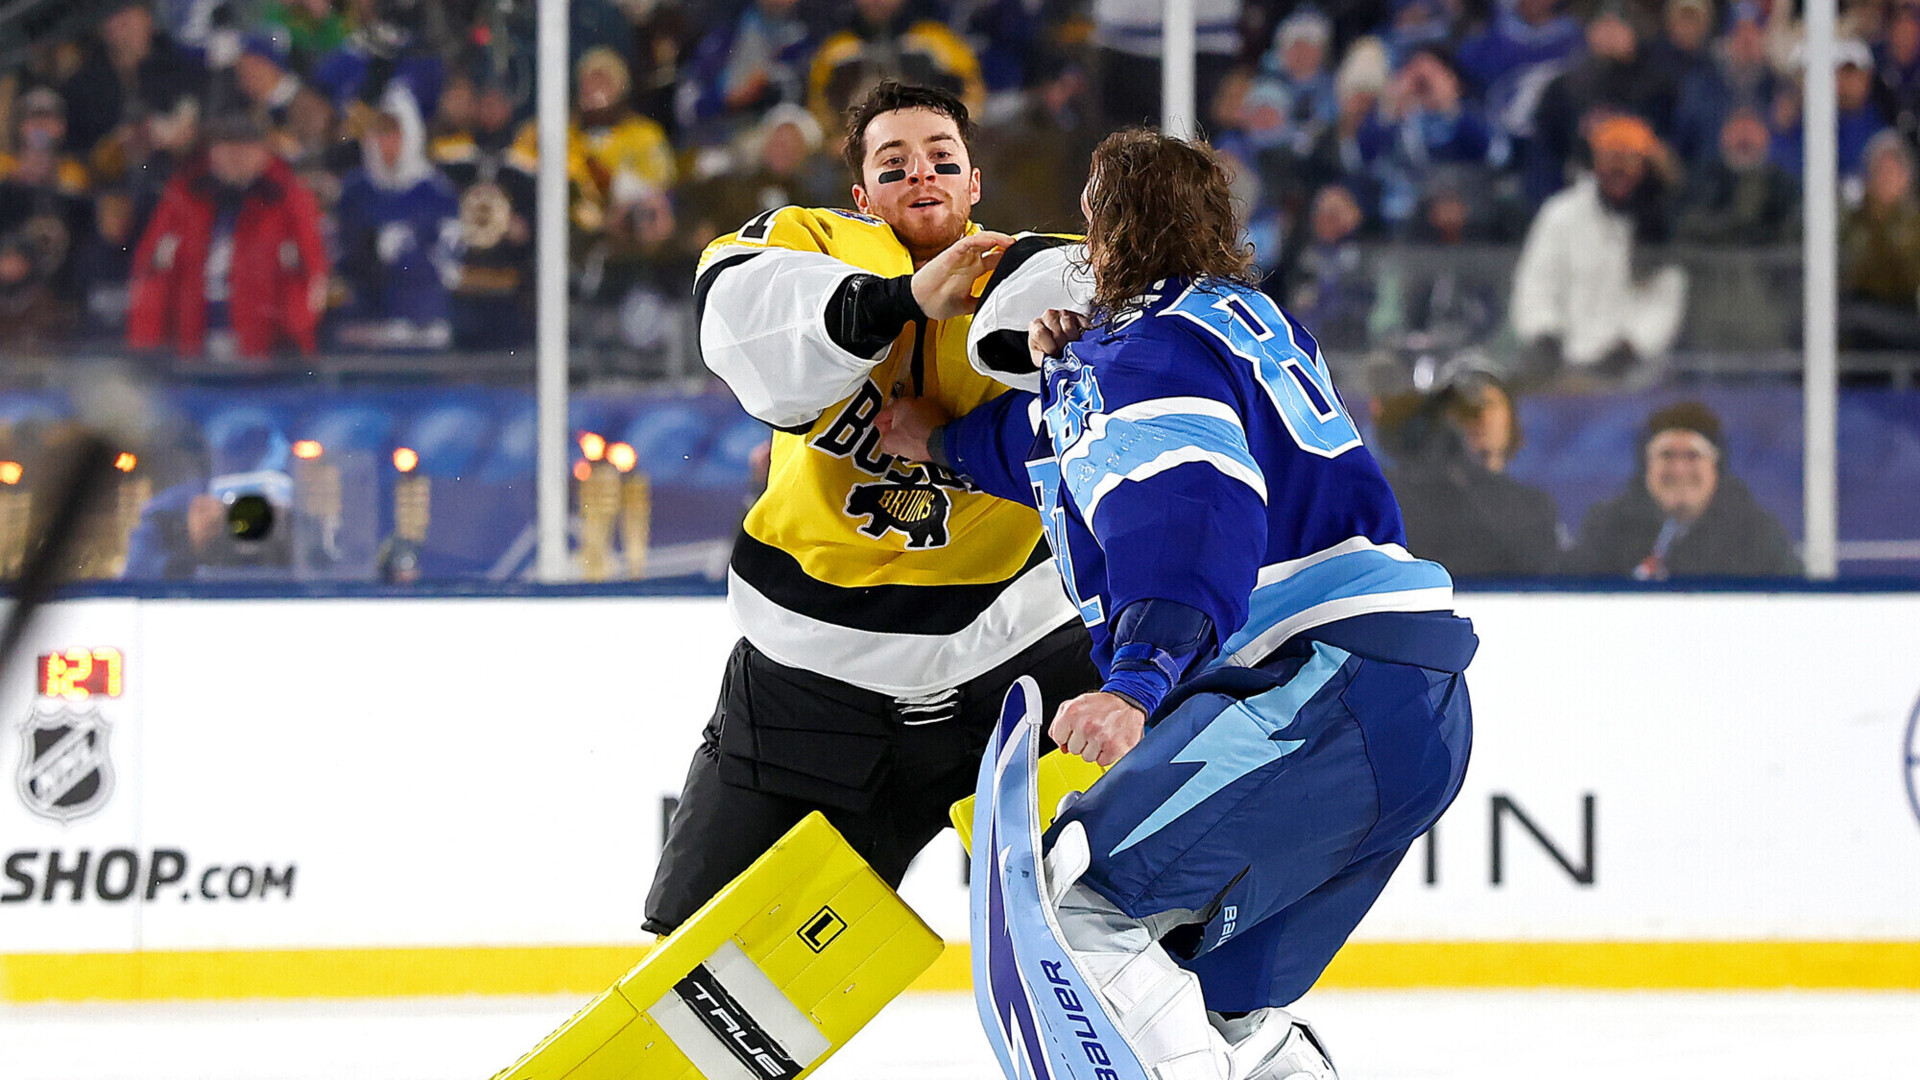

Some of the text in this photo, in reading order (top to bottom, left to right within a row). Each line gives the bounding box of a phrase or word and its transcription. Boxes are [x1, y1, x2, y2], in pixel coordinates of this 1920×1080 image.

[878, 488, 936, 524] BRUINS
[0, 848, 296, 903] SHOP.COM
[804, 912, 834, 947] L
[692, 980, 787, 1078] TRUE
